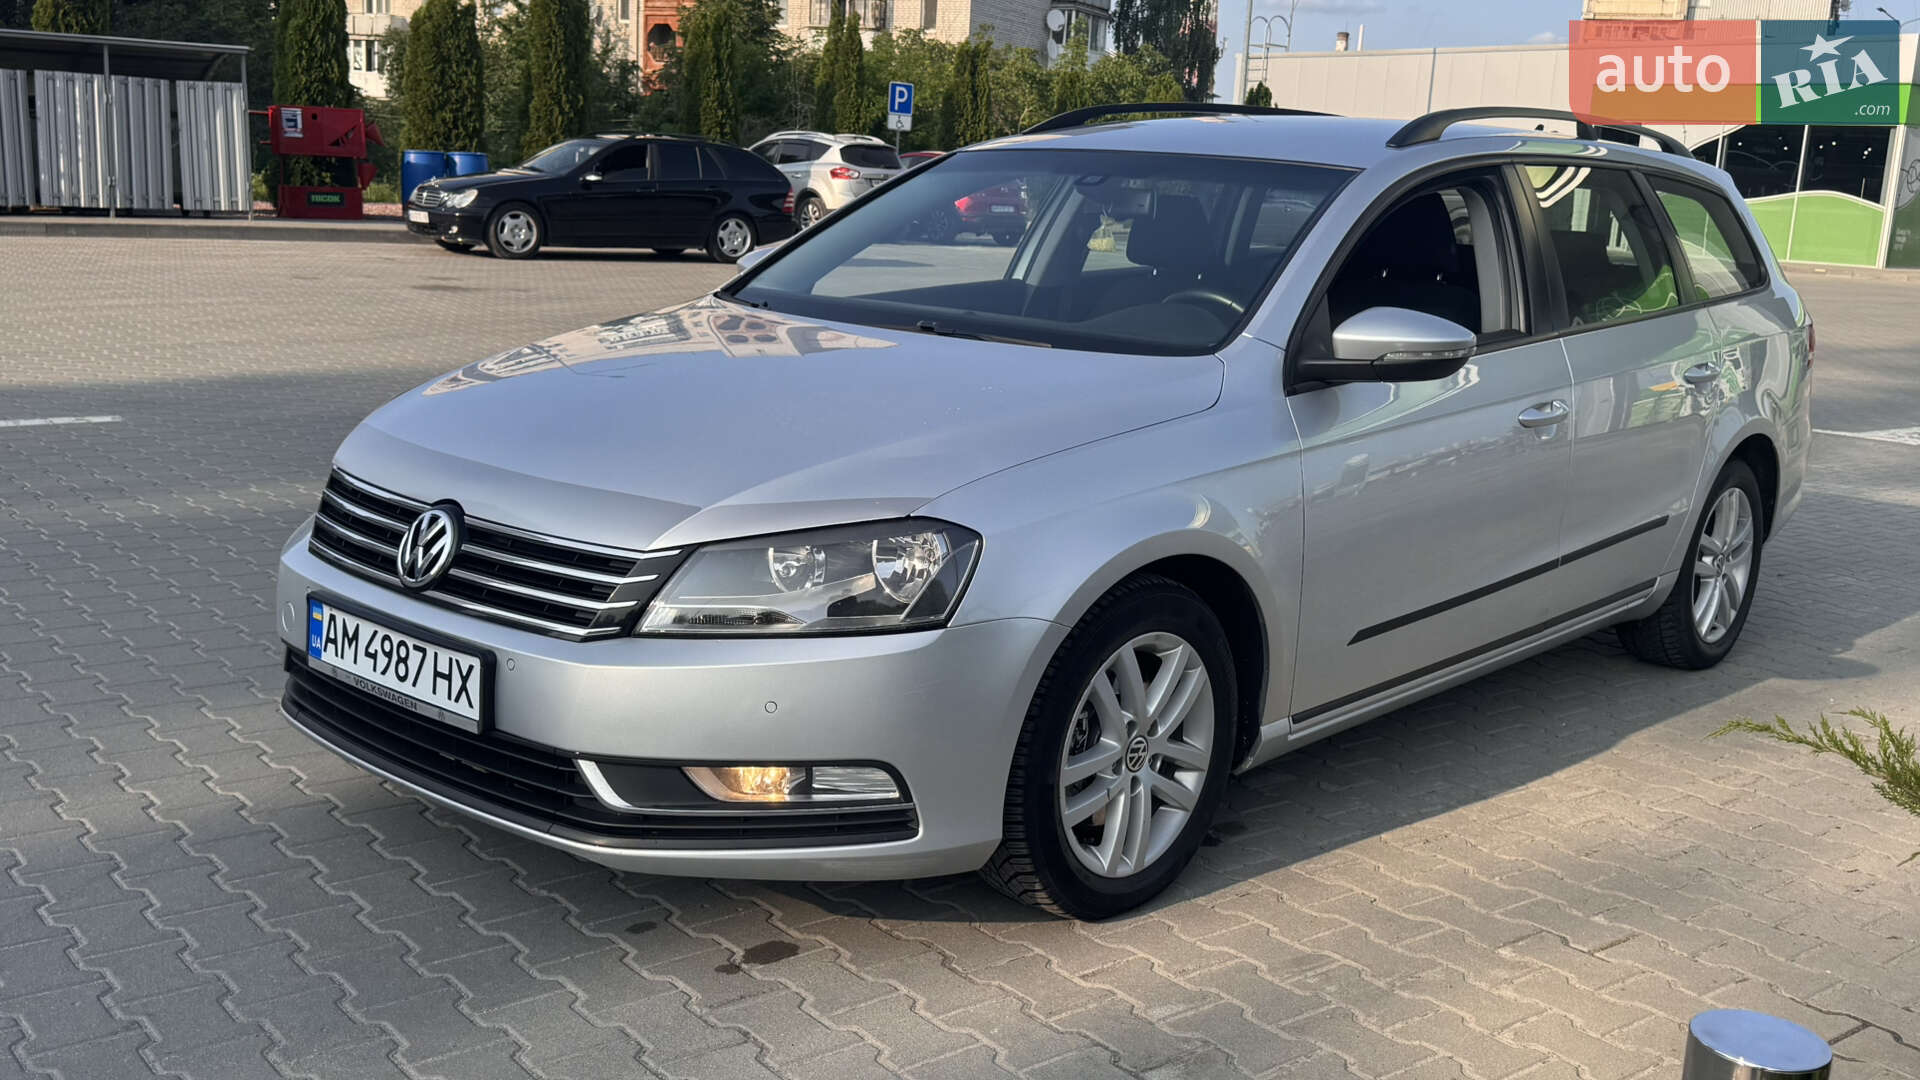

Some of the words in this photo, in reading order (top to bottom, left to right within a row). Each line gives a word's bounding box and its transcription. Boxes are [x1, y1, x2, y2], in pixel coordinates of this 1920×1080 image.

[894, 86, 909, 111] P
[311, 634, 321, 650] UA
[323, 613, 359, 665] AM
[364, 630, 427, 687] 4987
[432, 652, 474, 709] HX
[353, 677, 418, 711] VOLKSWAGEN
